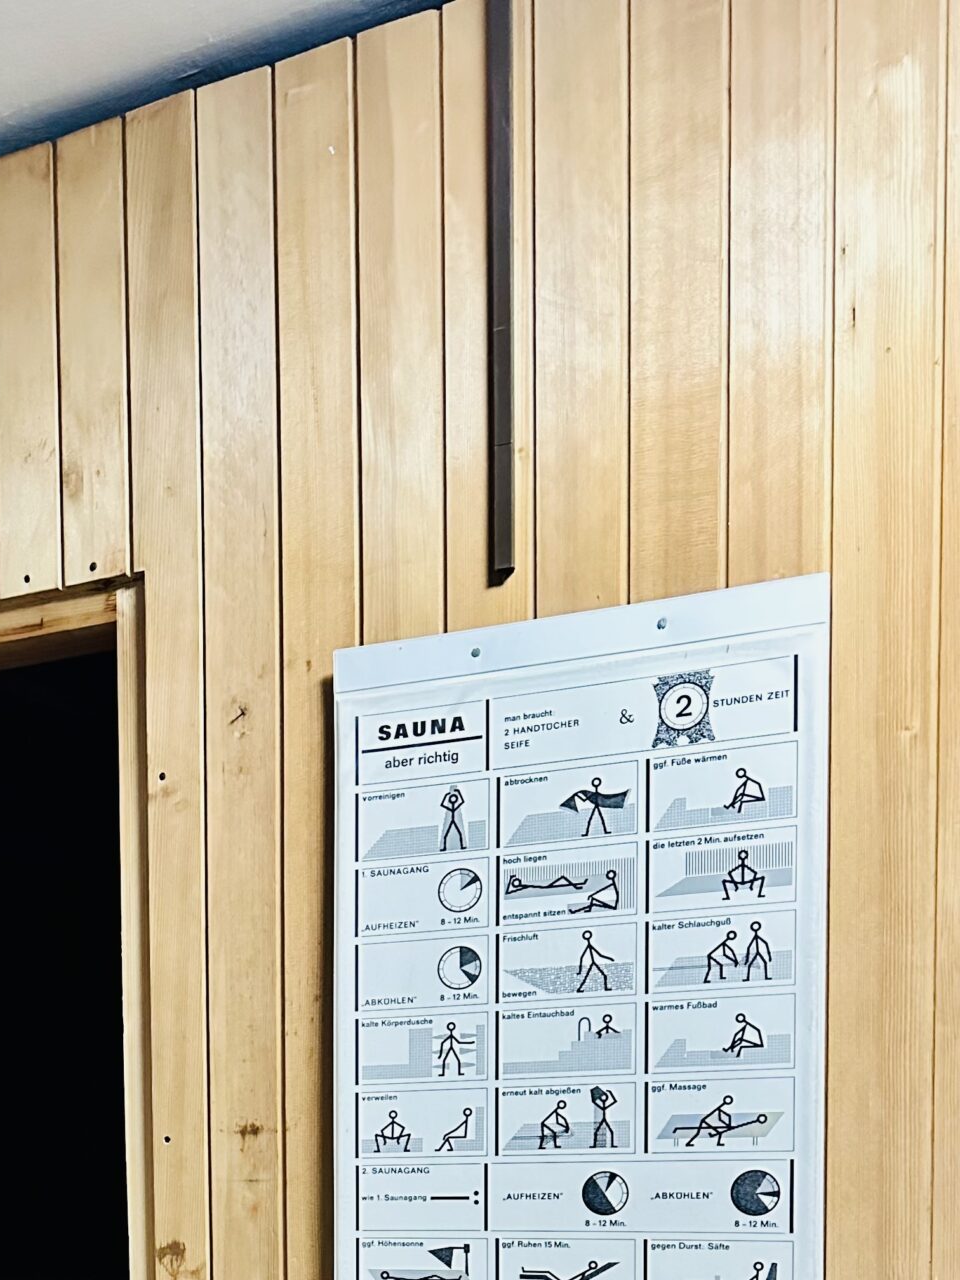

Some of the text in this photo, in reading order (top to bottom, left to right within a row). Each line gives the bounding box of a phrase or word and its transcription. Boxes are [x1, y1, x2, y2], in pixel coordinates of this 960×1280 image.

[713, 690, 790, 707] STUNDEN ZEIT
[676, 694, 692, 717] 2
[619, 709, 634, 724] &
[378, 716, 465, 741] SAUNA
[504, 719, 579, 736] 2 HANDTÜCHER
[504, 740, 530, 750] SEIFE
[385, 751, 459, 768] aber richtig
[653, 759, 668, 770] ggf.
[694, 753, 727, 764] wärmen
[504, 775, 548, 786] abtrocknen
[362, 792, 406, 802] vorreinigen
[668, 840, 695, 848] letzten
[704, 836, 722, 844] Min.
[724, 833, 764, 842] aufsetzen
[503, 854, 547, 864] hoch liegen
[370, 866, 429, 877] SAUNAGANG
[503, 911, 540, 920] entspannt
[678, 918, 731, 929] Schlauchguß
[503, 934, 538, 942] Frischluft
[502, 990, 536, 998] bewegen
[687, 1001, 717, 1009] Fußbad
[502, 1010, 574, 1020] kaltes Eintauchbad
[382, 1018, 433, 1027] Körperdusche
[546, 1087, 581, 1095] abgießen
[652, 1083, 706, 1092] ggf. Massage
[384, 1194, 427, 1202] Saunagang
